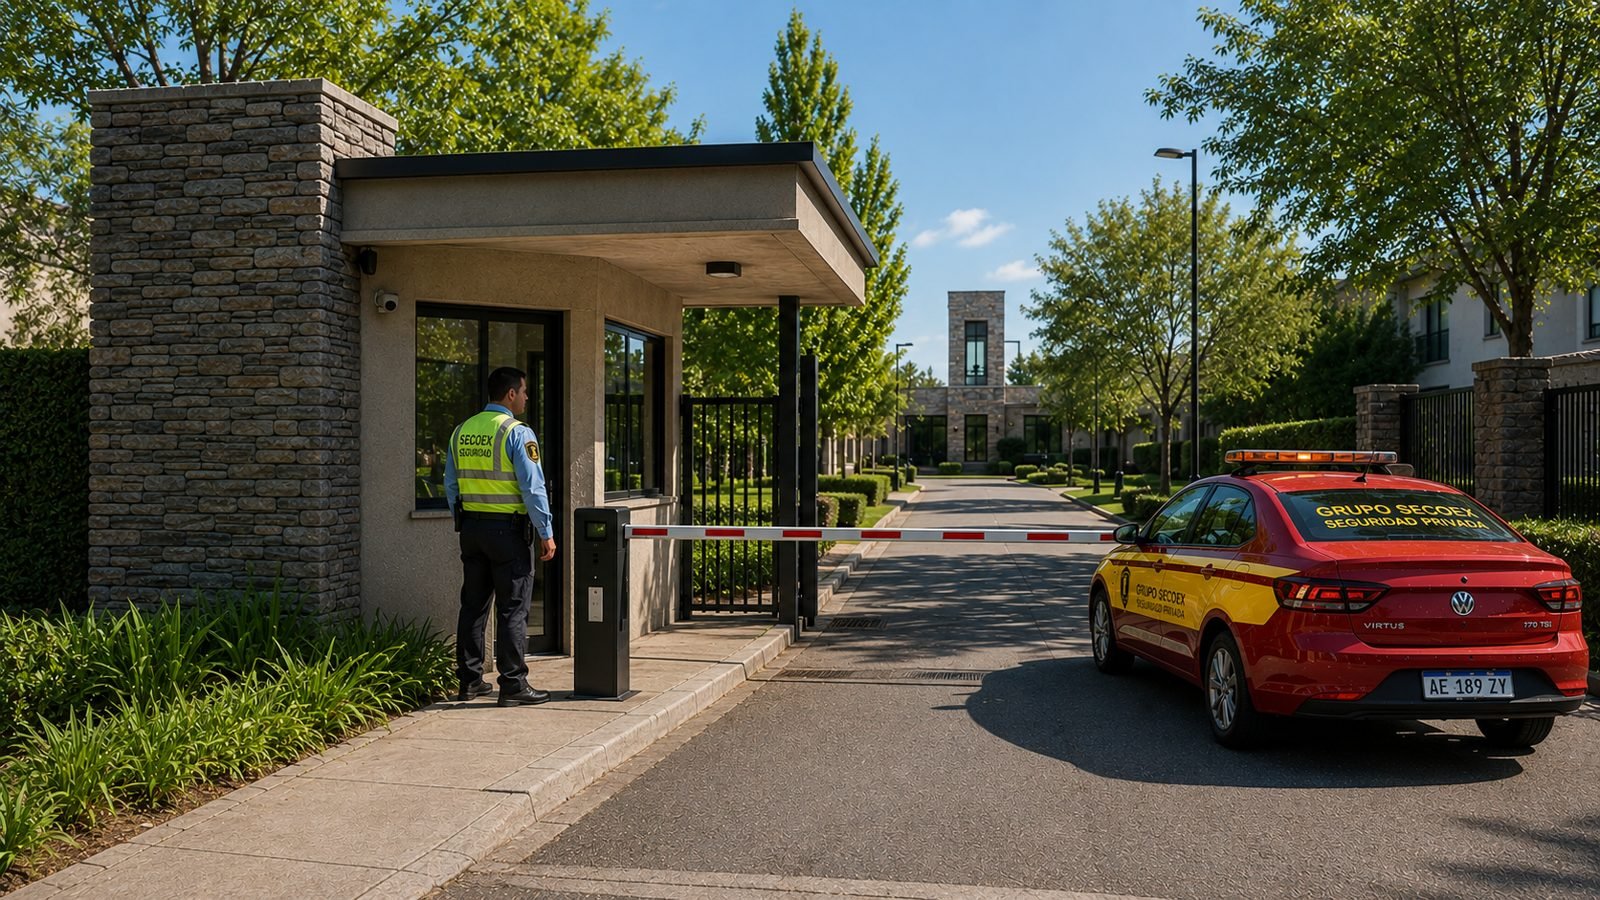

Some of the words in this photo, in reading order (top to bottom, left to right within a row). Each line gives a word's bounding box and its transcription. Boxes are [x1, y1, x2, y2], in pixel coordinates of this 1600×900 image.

[460, 434, 493, 446] SECOEX
[1316, 504, 1391, 517] GRUPO
[1396, 504, 1479, 518] SECOEX
[1324, 517, 1418, 529] SEGURIDAD
[1423, 517, 1489, 529] PRIVADA
[1136, 584, 1157, 599] GRUPO
[1158, 588, 1186, 605] SECOEX
[1363, 622, 1405, 630] VIRTUS
[1430, 678, 1449, 695] AE
[1455, 678, 1482, 694] 189
[1488, 678, 1506, 694] ZY
